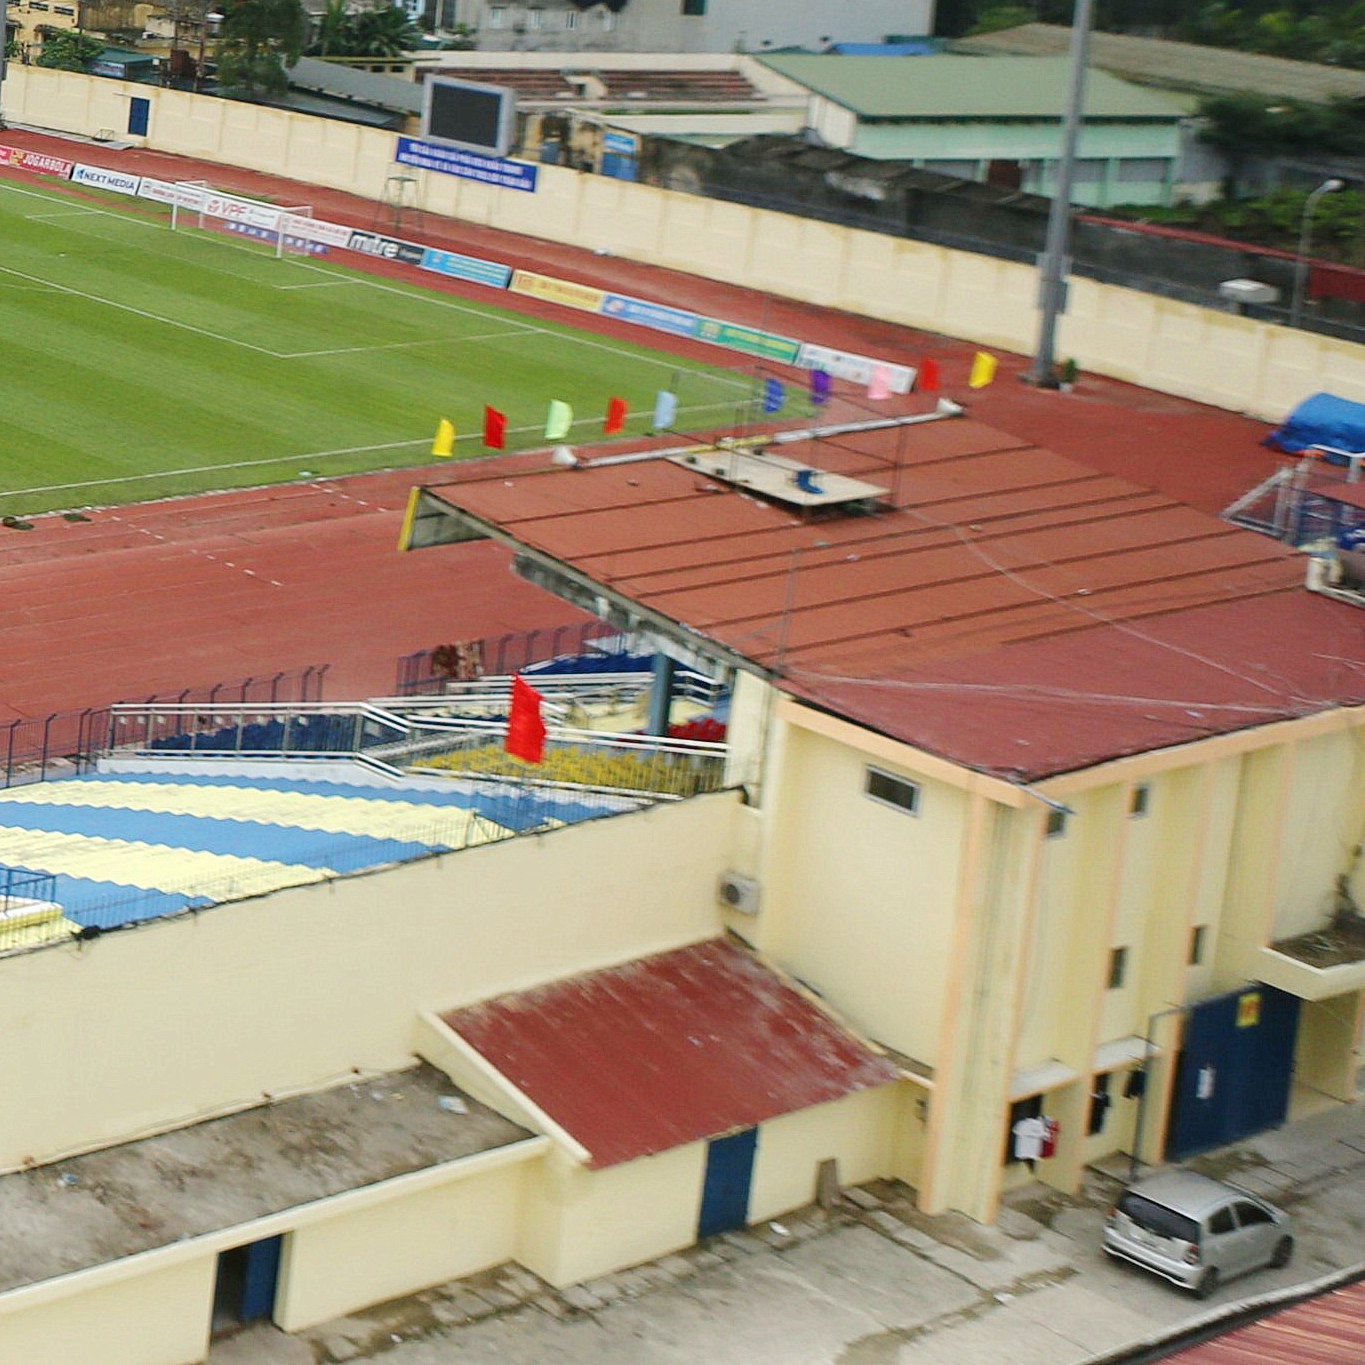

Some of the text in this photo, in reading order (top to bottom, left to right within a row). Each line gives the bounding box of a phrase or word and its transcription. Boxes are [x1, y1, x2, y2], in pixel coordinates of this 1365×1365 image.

[23, 153, 71, 174] JOGARBOLA
[84, 171, 135, 191] NEXT MEDIA
[221, 201, 248, 216] VPF
[349, 233, 399, 259] mitre
